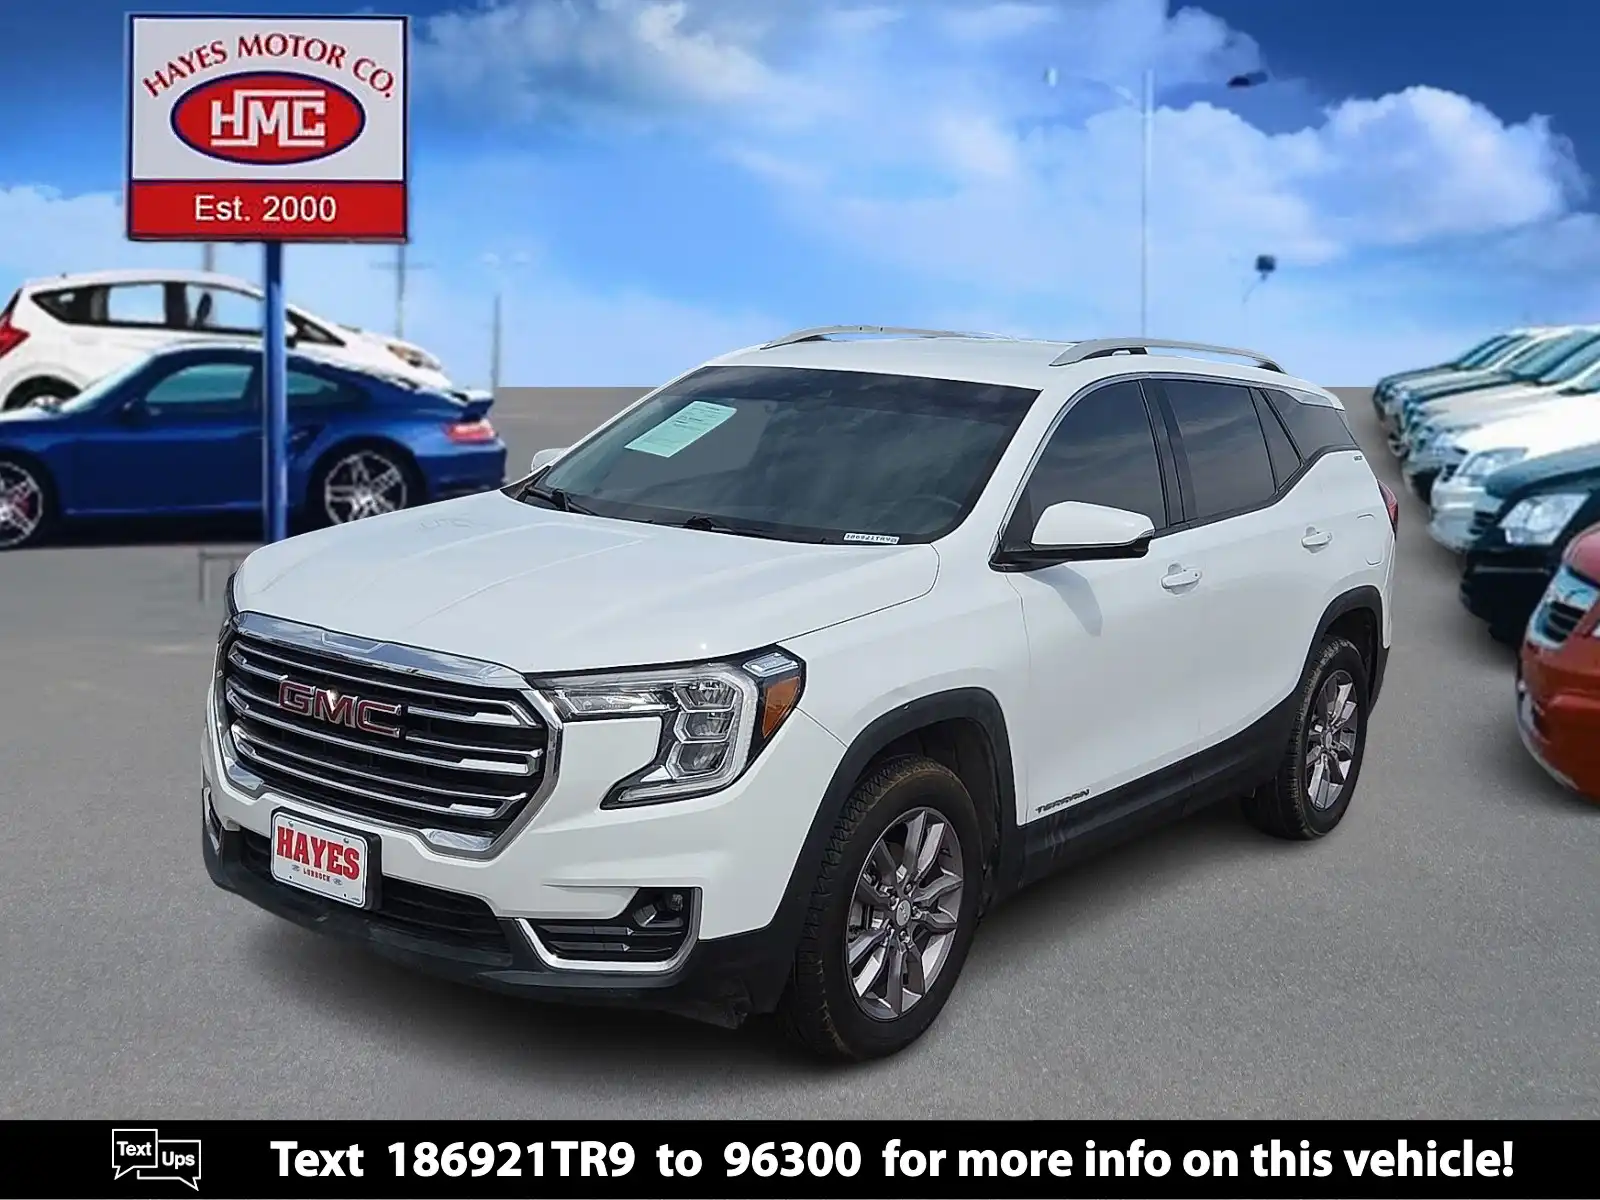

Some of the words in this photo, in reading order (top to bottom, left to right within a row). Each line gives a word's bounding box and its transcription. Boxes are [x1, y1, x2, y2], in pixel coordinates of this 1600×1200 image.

[143, 40, 228, 97] HAYES
[237, 33, 347, 69] MOTOR
[352, 56, 395, 98] CO.
[211, 89, 326, 147] HMC
[195, 194, 250, 222] Est.
[262, 195, 337, 222] 2000
[278, 680, 402, 738] GMC
[276, 826, 361, 880] HAYES
